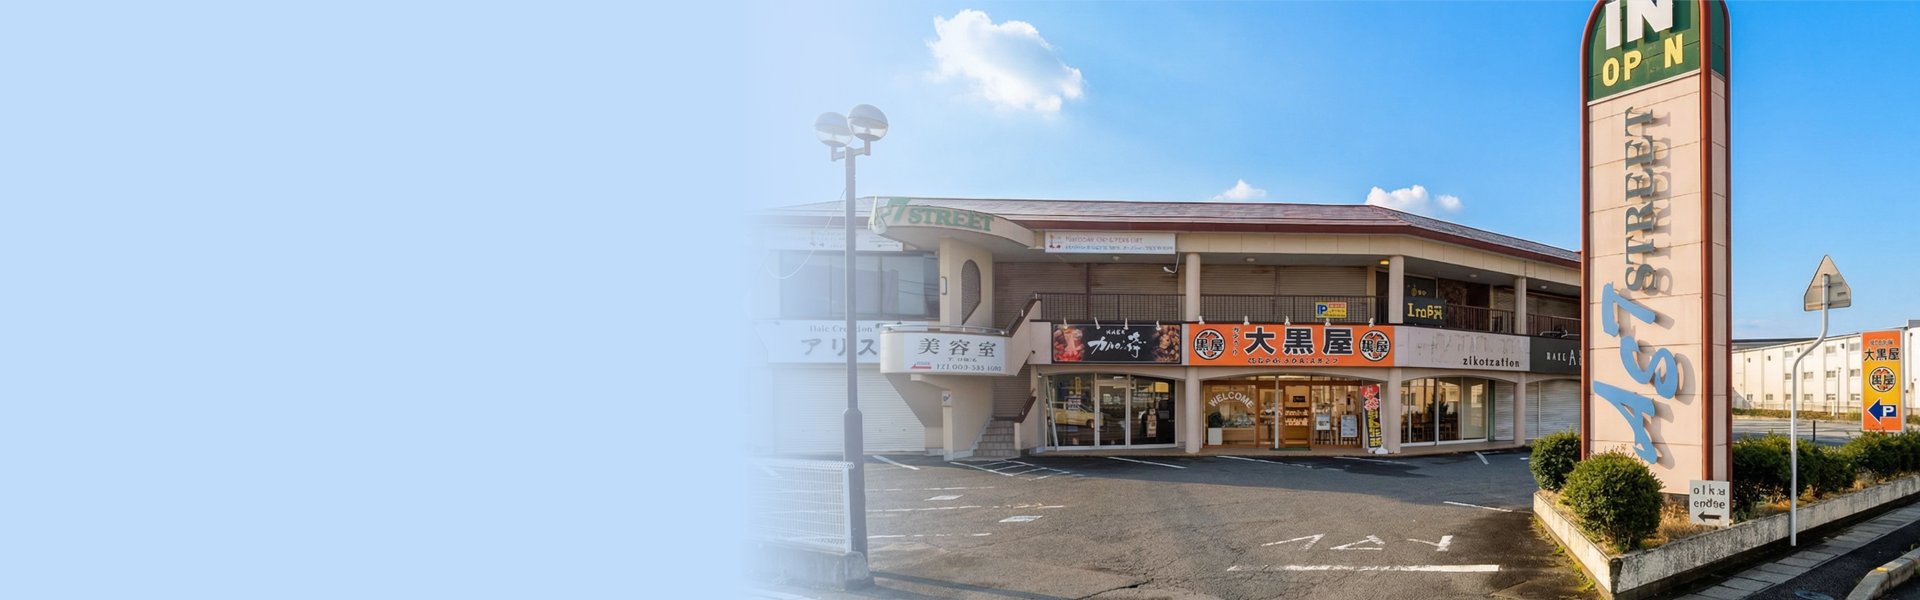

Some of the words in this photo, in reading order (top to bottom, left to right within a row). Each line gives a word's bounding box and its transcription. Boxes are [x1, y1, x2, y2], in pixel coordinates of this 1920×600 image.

[1625, 106, 1656, 293] STREET
[907, 207, 994, 232] STREET
[918, 338, 996, 358] 美容室
[1244, 326, 1353, 356] 大黒屋
[1864, 347, 1900, 361] 大黒屋
[1208, 391, 1254, 408] WELCOME
[1882, 405, 1894, 416] P
